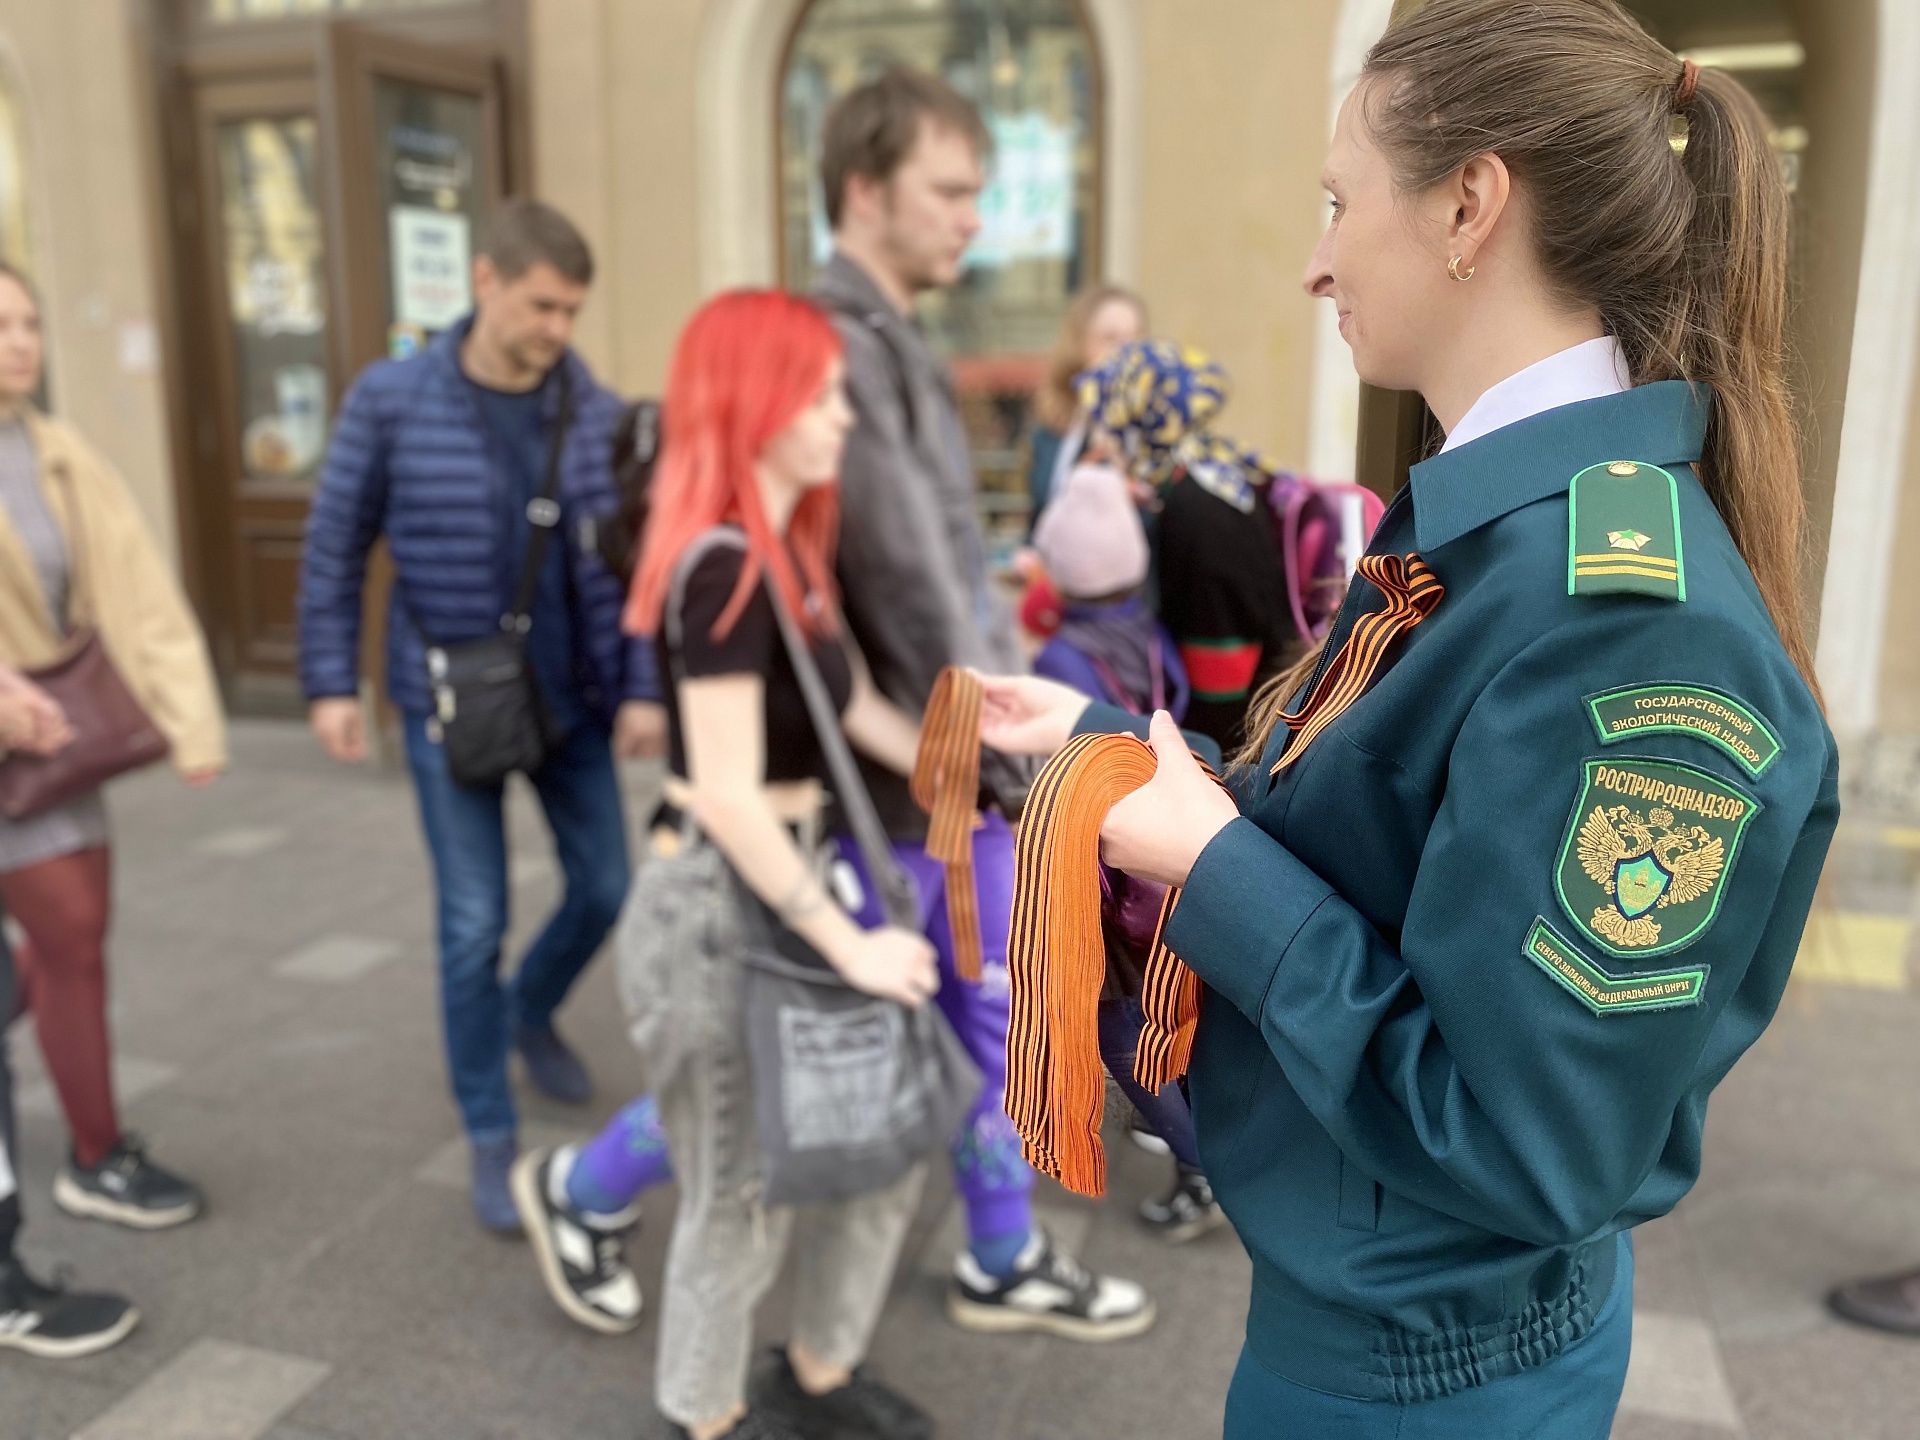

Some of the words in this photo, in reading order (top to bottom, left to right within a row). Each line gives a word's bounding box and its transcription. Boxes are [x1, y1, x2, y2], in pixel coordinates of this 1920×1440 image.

[1611, 712, 1722, 736] ЭКОЛОГИЧЕСКИЙ
[1720, 728, 1761, 764] НАДЗОР
[1635, 696, 1753, 735] ГОСУДАРСТВЕННЫЙ
[1595, 766, 1744, 821] РОСПРИРОДНАДЗОР
[1598, 984, 1663, 1003] ФЕДЕРАЛЬНЫЙ
[1665, 981, 1690, 994] ОКРУГ
